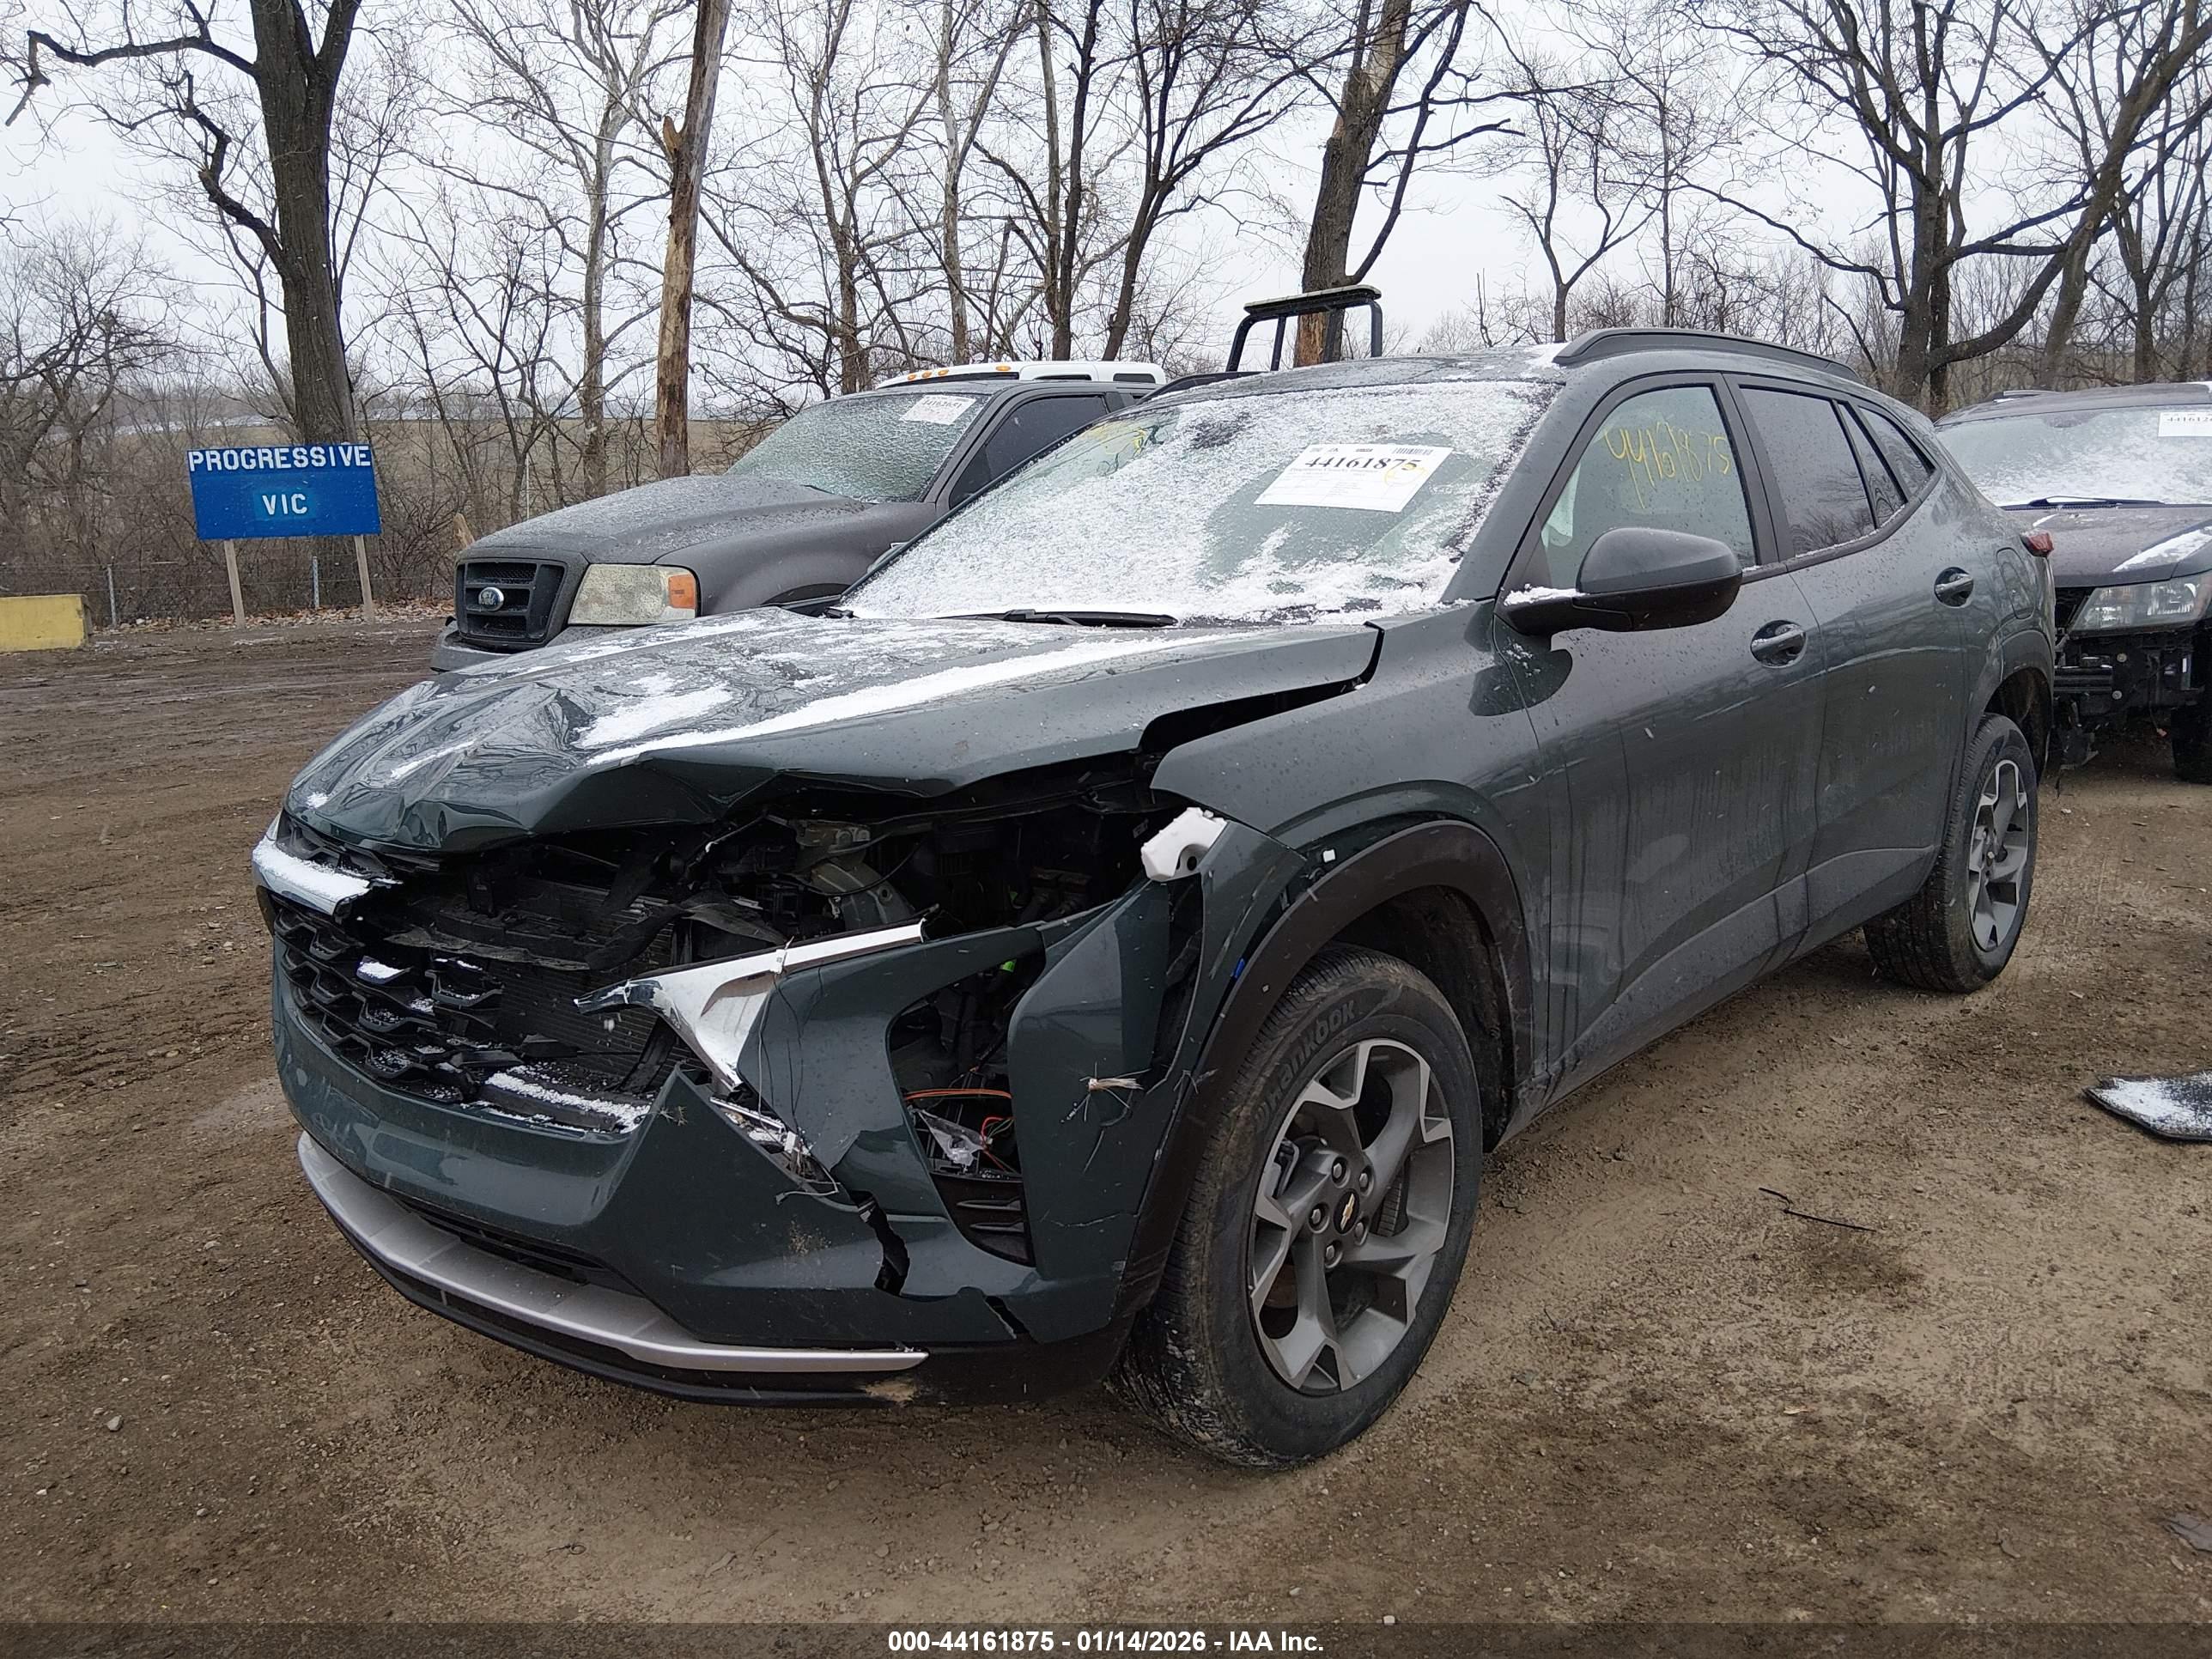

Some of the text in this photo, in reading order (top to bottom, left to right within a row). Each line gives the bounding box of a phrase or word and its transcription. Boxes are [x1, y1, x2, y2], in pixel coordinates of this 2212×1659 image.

[188, 445, 371, 471] PROGRESSIVE
[1304, 456, 1423, 471] 44161875
[262, 493, 308, 515] VIC
